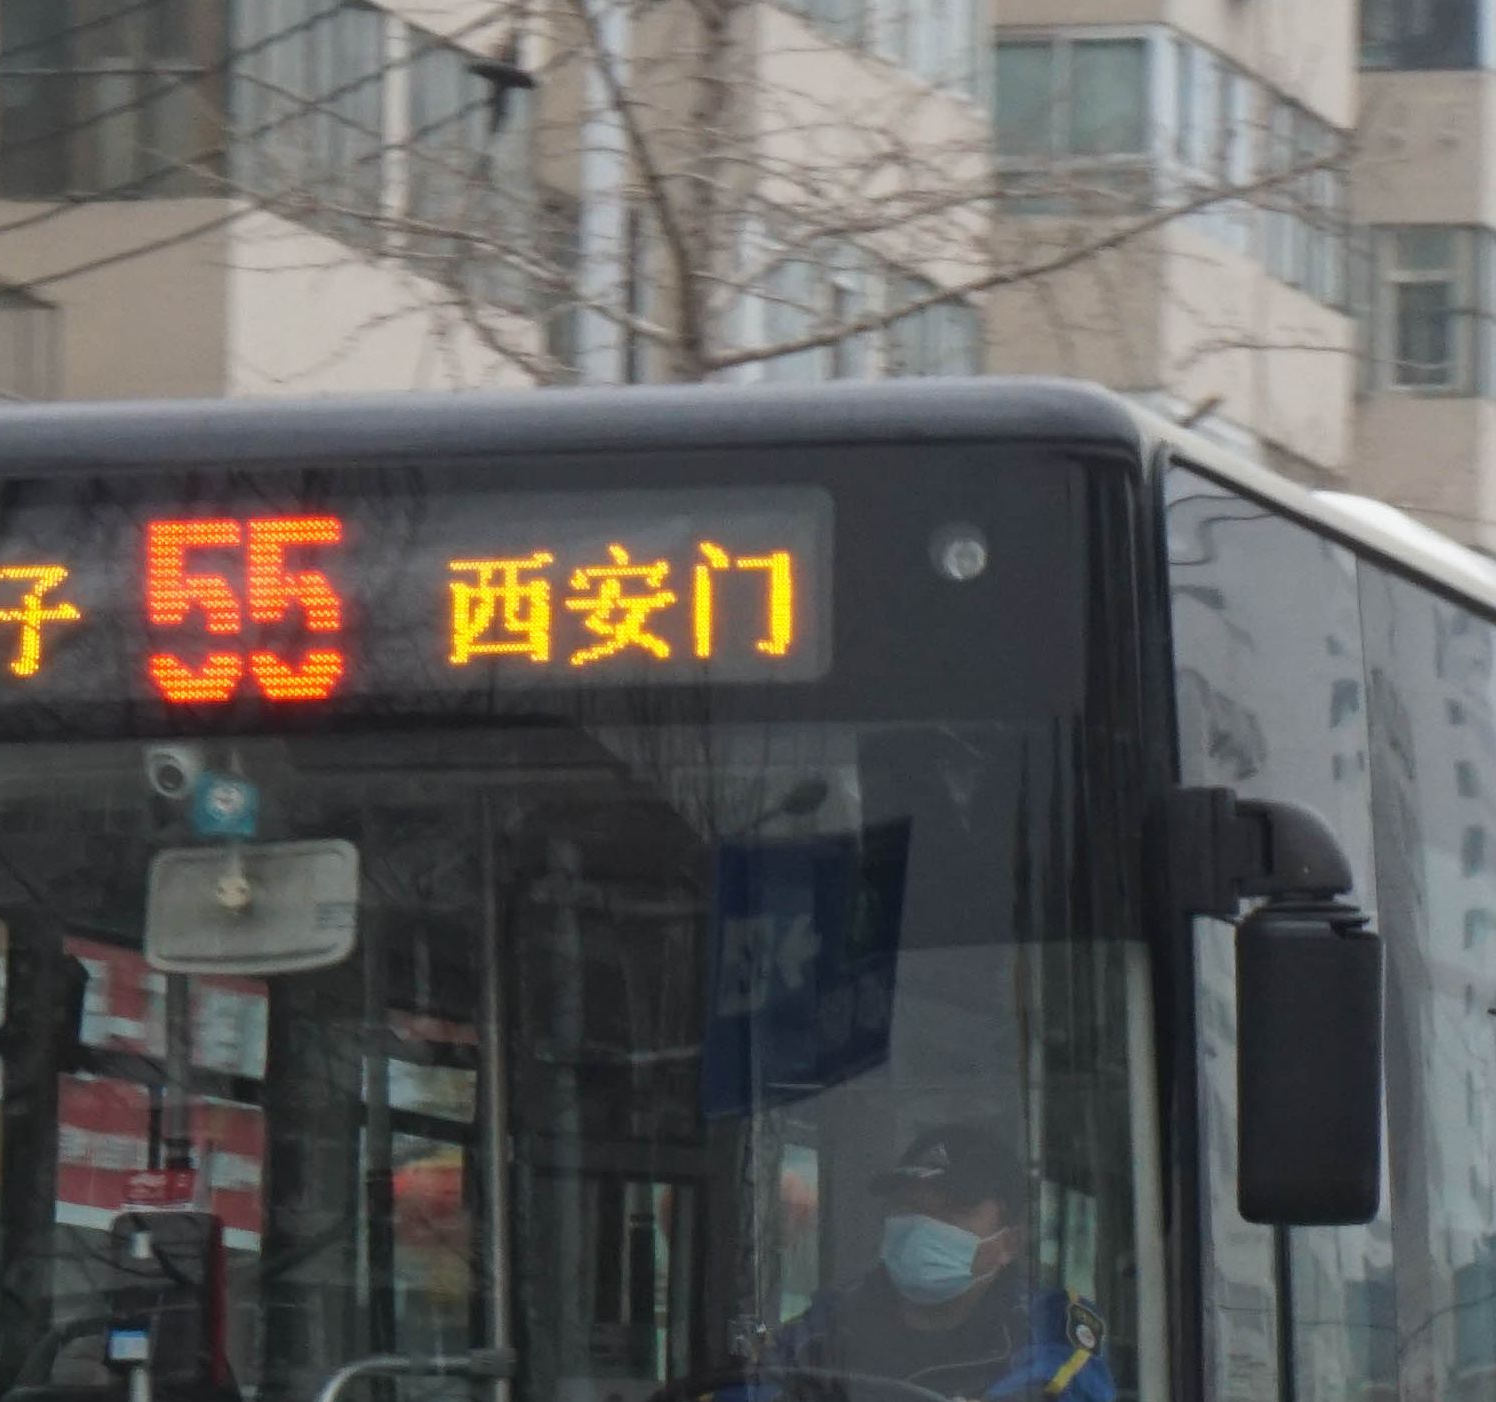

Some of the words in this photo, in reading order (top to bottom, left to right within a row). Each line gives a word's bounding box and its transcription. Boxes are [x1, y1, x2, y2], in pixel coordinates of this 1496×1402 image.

[147, 516, 342, 702] 55
[448, 542, 793, 666] 西安门
